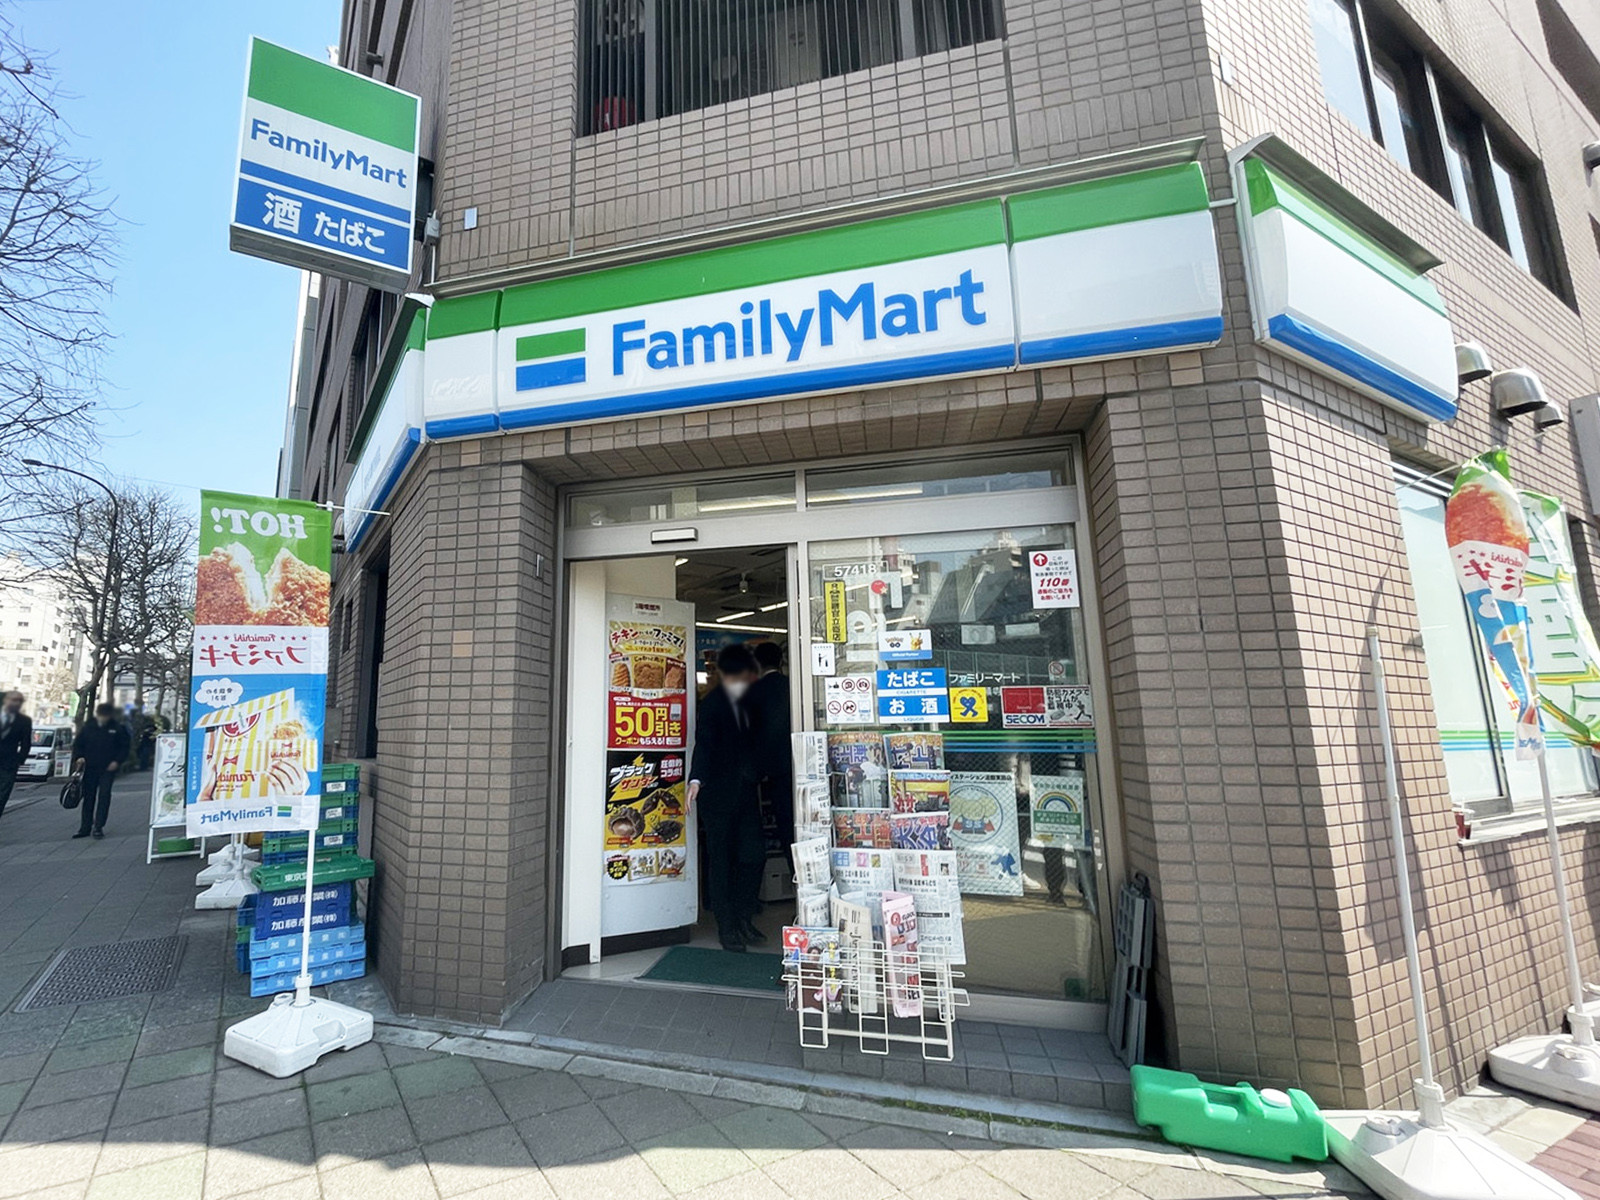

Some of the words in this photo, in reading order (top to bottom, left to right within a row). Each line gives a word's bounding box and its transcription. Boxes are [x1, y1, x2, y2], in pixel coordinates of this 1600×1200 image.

[251, 118, 407, 189] FamilyMart
[262, 192, 302, 234] 酒
[313, 211, 385, 255] たばこ
[613, 269, 987, 376] FamilyMart
[834, 563, 877, 577] 57418
[1040, 577, 1069, 587] 110番
[887, 671, 935, 688] たばこ
[949, 672, 1021, 684] ファミリーマート
[1006, 715, 1045, 724] SECOM
[609, 763, 655, 787] ブラック
